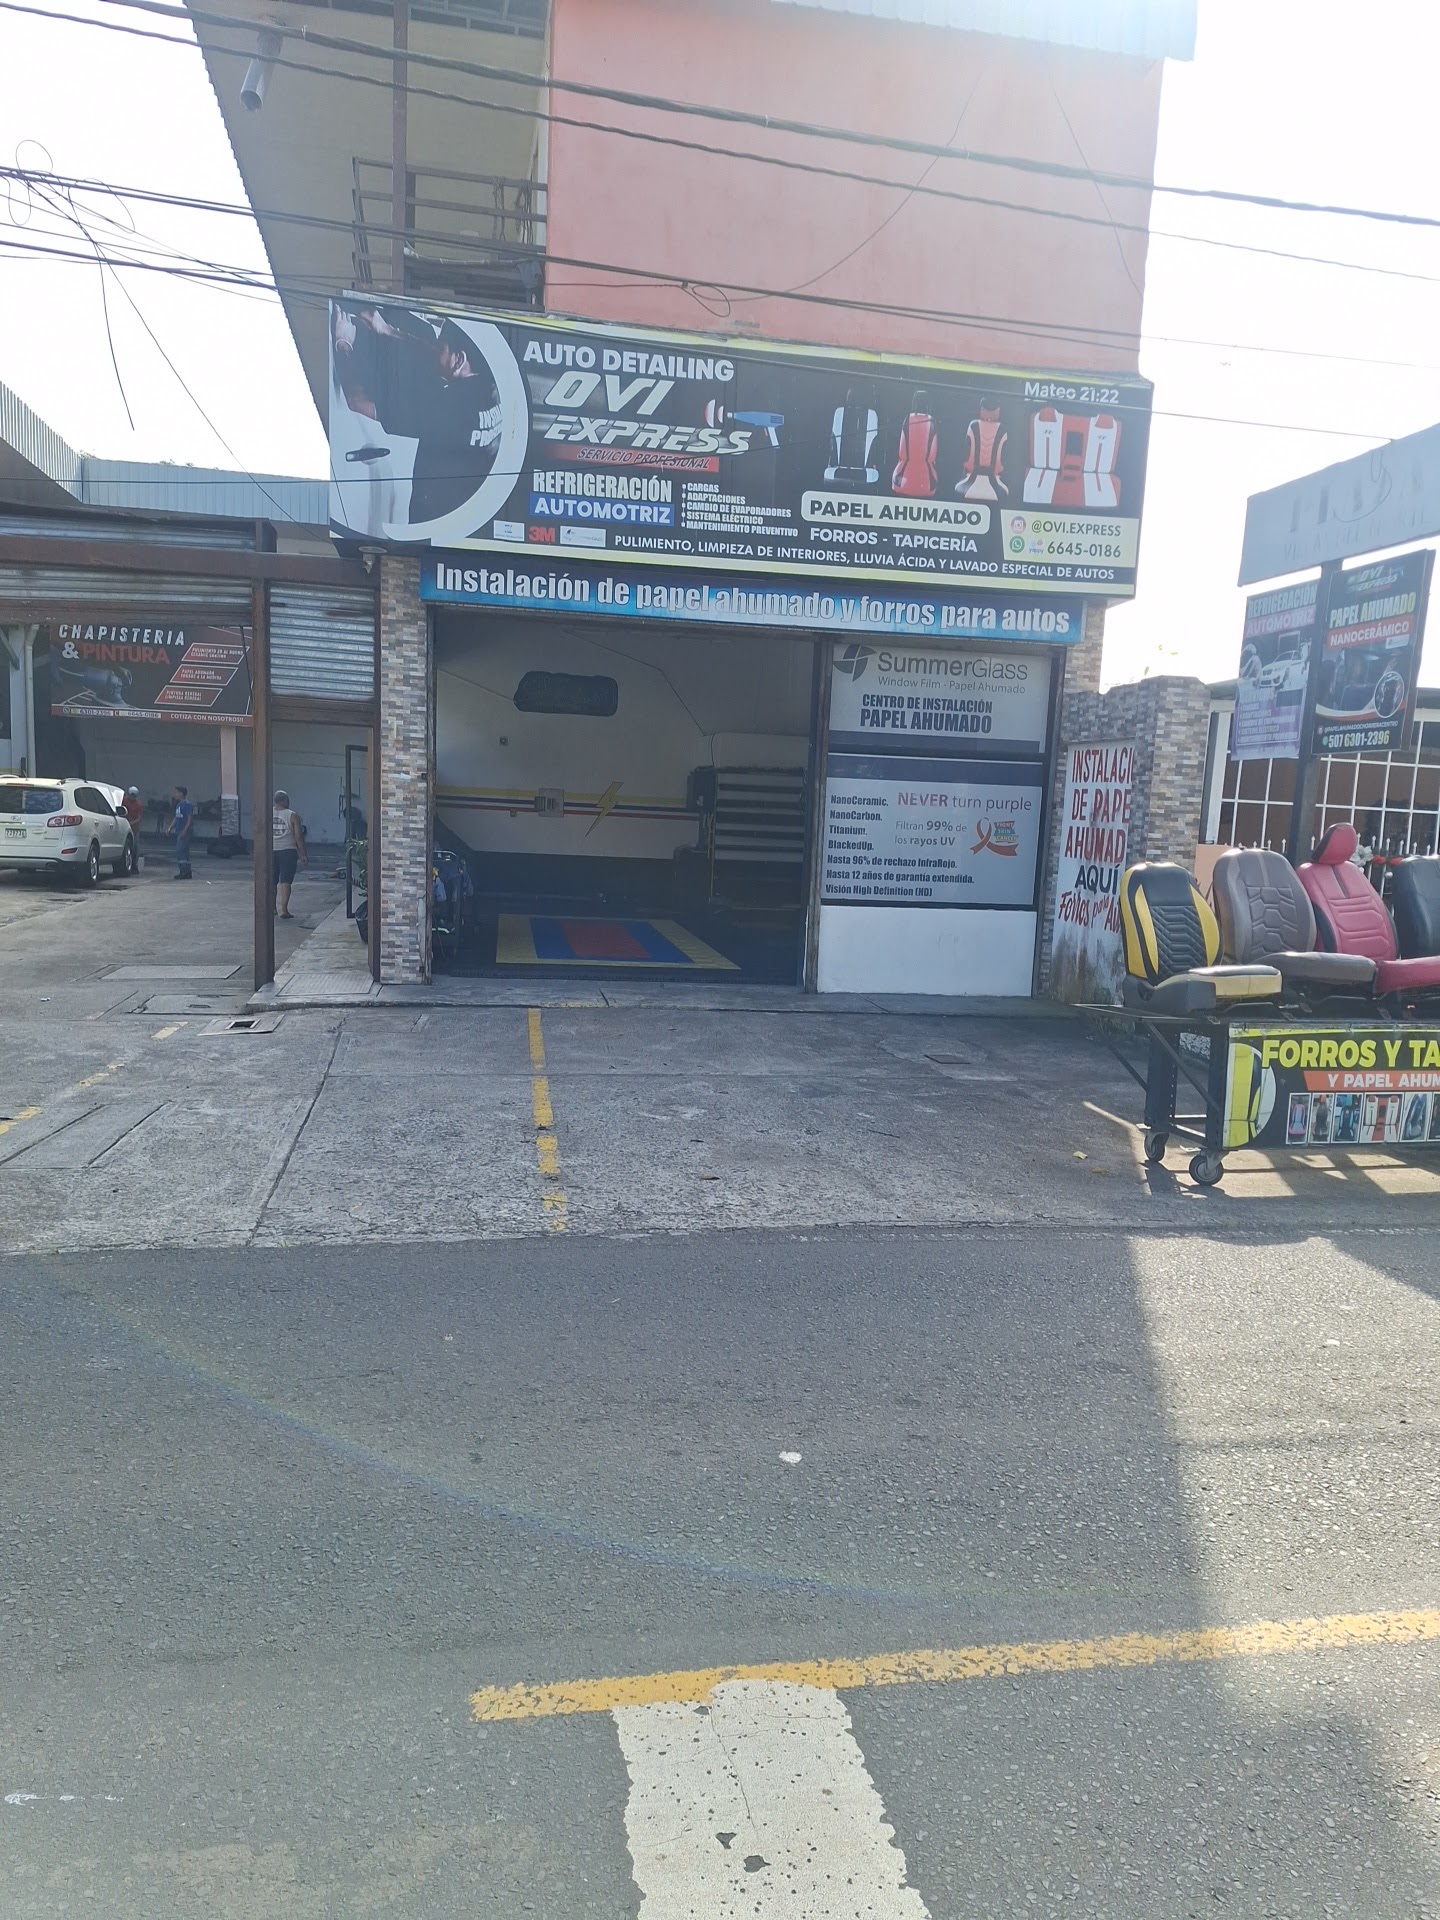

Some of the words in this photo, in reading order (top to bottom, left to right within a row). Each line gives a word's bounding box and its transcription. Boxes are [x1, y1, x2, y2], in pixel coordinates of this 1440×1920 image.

[524, 340, 596, 368] AUTO
[602, 349, 734, 381] DETAILING
[544, 370, 676, 416] OVI
[1024, 381, 1076, 400] Mateo
[1080, 386, 1120, 404] 21:22
[544, 414, 752, 455] EXPRESS
[576, 448, 632, 463] SERVICIO
[634, 453, 712, 470] PROFESIONAL
[533, 469, 672, 503] REFRIGERACIÓN
[687, 482, 720, 494] CARGAS
[687, 492, 746, 505] ADAPTACIONES
[534, 497, 671, 524] AUTOMOTRIZ
[686, 502, 718, 512] CAMBIO
[720, 504, 730, 513] DE
[731, 504, 792, 518] EVAPORADORES
[686, 512, 721, 522] SISTEMA
[810, 499, 874, 519] PAPEL
[878, 504, 982, 526] AHUMADO
[528, 526, 556, 543] 3M
[686, 520, 750, 534] MANTENIMIENTO
[751, 525, 799, 537] PREVENTIVO
[1031, 520, 1122, 537] @OVI.EXPRESS
[810, 527, 878, 545] FORROS
[892, 534, 978, 553] TAPICERÍA
[1047, 541, 1122, 558] 6645-0186
[615, 535, 695, 554] PULIMIENTO,
[698, 541, 754, 556] LIMPIEZA
[757, 546, 773, 557] DE
[777, 547, 850, 564] INTERIORES,
[854, 552, 895, 566] LLUVIA
[898, 553, 936, 569] ÁCIDA
[939, 558, 947, 569] Y
[950, 560, 998, 573] LAVADO
[1002, 563, 1054, 577] ESPECIAL
[1056, 566, 1072, 578] DE
[1074, 568, 1115, 580] AUTOS
[436, 562, 590, 603] Instalación
[597, 577, 630, 606] de
[636, 583, 710, 612] papel
[714, 587, 836, 620] ahumado
[840, 598, 856, 623] y
[860, 596, 935, 626] forros
[940, 606, 996, 630] para
[1001, 606, 1070, 634] autos
[1330, 604, 1360, 629] PAPEL
[1360, 592, 1416, 622] AHUMADO
[58, 624, 185, 646] CHAPISTERIA
[1330, 621, 1410, 646] NANOCERÁMICO
[62, 642, 80, 659] &
[82, 642, 171, 664] PINTURA
[877, 651, 1028, 680] SummerGlass
[878, 676, 918, 688] Window
[920, 678, 941, 689] Film
[950, 681, 976, 693] Papel
[978, 682, 1026, 694] Ahumado
[862, 693, 905, 709] CENTRO
[906, 696, 920, 710] DE
[922, 697, 993, 714] INSTALACIÓN
[860, 708, 907, 730] PAPEL
[910, 712, 992, 734] AHUMADO
[1328, 734, 1344, 748] 507
[1344, 730, 1390, 747] 6301-2396
[1072, 746, 1134, 784] INSTALACI
[830, 794, 889, 806] NanoCeramic.
[897, 792, 948, 807] NEVER
[952, 795, 982, 808] turn
[986, 796, 1032, 814] purple
[1072, 788, 1088, 821] DE
[830, 810, 883, 822] NanoCarbon.
[896, 820, 924, 831] Filtran
[926, 820, 954, 832] 99%
[956, 822, 967, 832] de
[828, 840, 874, 851] BlackedUp.
[894, 835, 908, 845] los
[910, 836, 938, 848] rayos
[940, 837, 956, 846] UV
[1064, 826, 1126, 864] AHUMAD
[827, 854, 851, 864] Hasta
[852, 855, 870, 865] 96%
[872, 856, 883, 866] de
[884, 857, 917, 868] rechazo
[918, 858, 958, 869] InfraRojo.
[826, 870, 850, 880] Hasta
[852, 870, 861, 880] 12
[862, 871, 882, 881] años
[884, 871, 894, 881] de
[932, 874, 975, 884] extendida.
[1074, 864, 1120, 895] AQUÍ
[825, 884, 852, 894] Visión
[853, 885, 872, 896] High
[874, 886, 914, 896] Definition
[915, 887, 933, 897] (HD)
[1262, 1040, 1377, 1068] FORROS
[1383, 1040, 1402, 1068] Y
[1409, 1040, 1440, 1068] TA
[1328, 1074, 1340, 1088] Y
[1344, 1073, 1394, 1088] PAPEL
